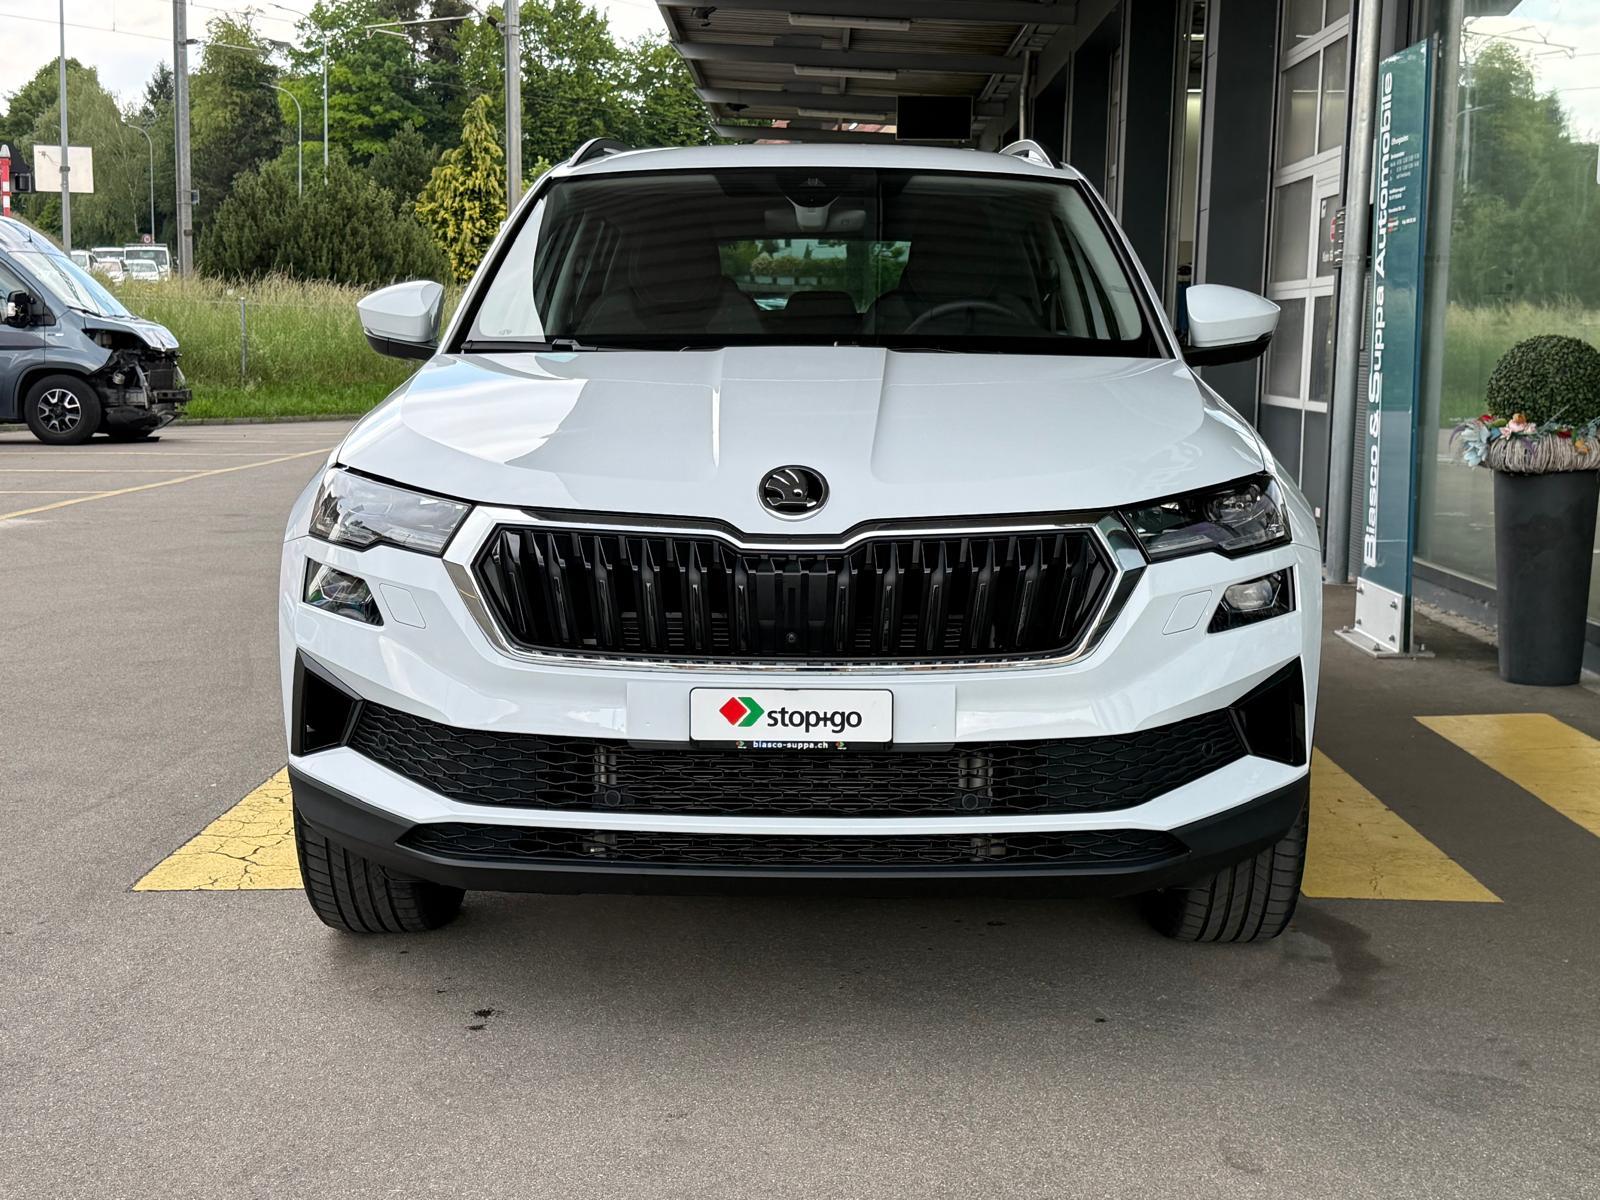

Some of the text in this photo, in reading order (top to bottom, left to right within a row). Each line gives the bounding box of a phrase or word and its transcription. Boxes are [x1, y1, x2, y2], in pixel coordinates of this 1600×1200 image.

[1364, 71, 1393, 568] Biasco & Suppa Automobile
[767, 707, 862, 733] stop+go
[753, 741, 829, 750] biasco-suppa.ch
